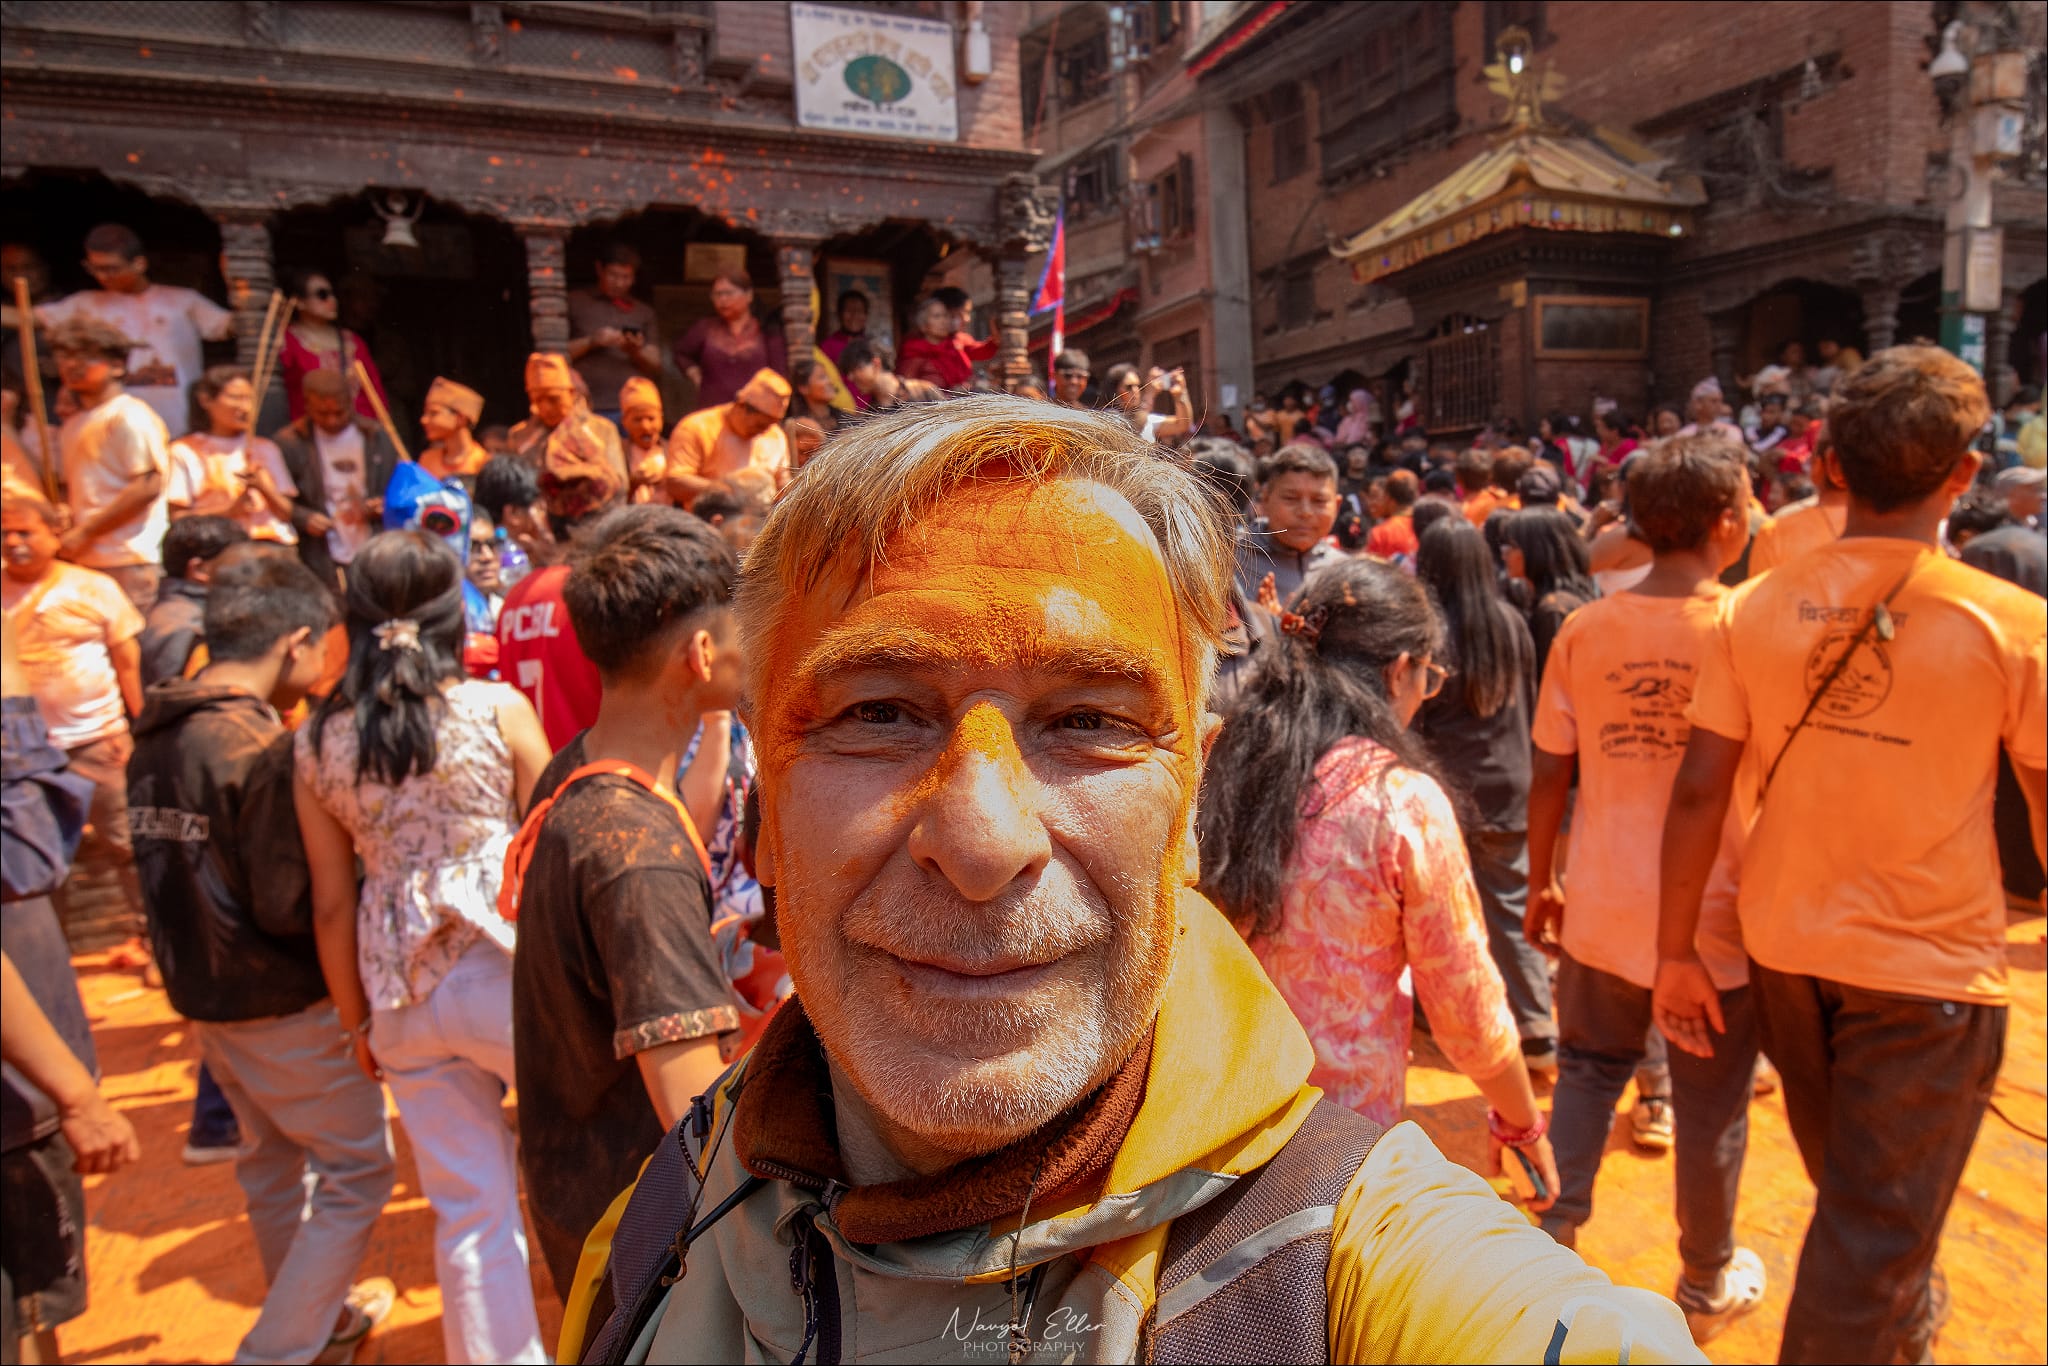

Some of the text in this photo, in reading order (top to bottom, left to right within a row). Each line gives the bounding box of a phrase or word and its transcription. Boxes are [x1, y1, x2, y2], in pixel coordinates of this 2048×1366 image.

[502, 602, 560, 645] PCBL
[517, 659, 543, 726] 7
[1816, 721, 1869, 738] Computer
[1873, 732, 1912, 747] Center
